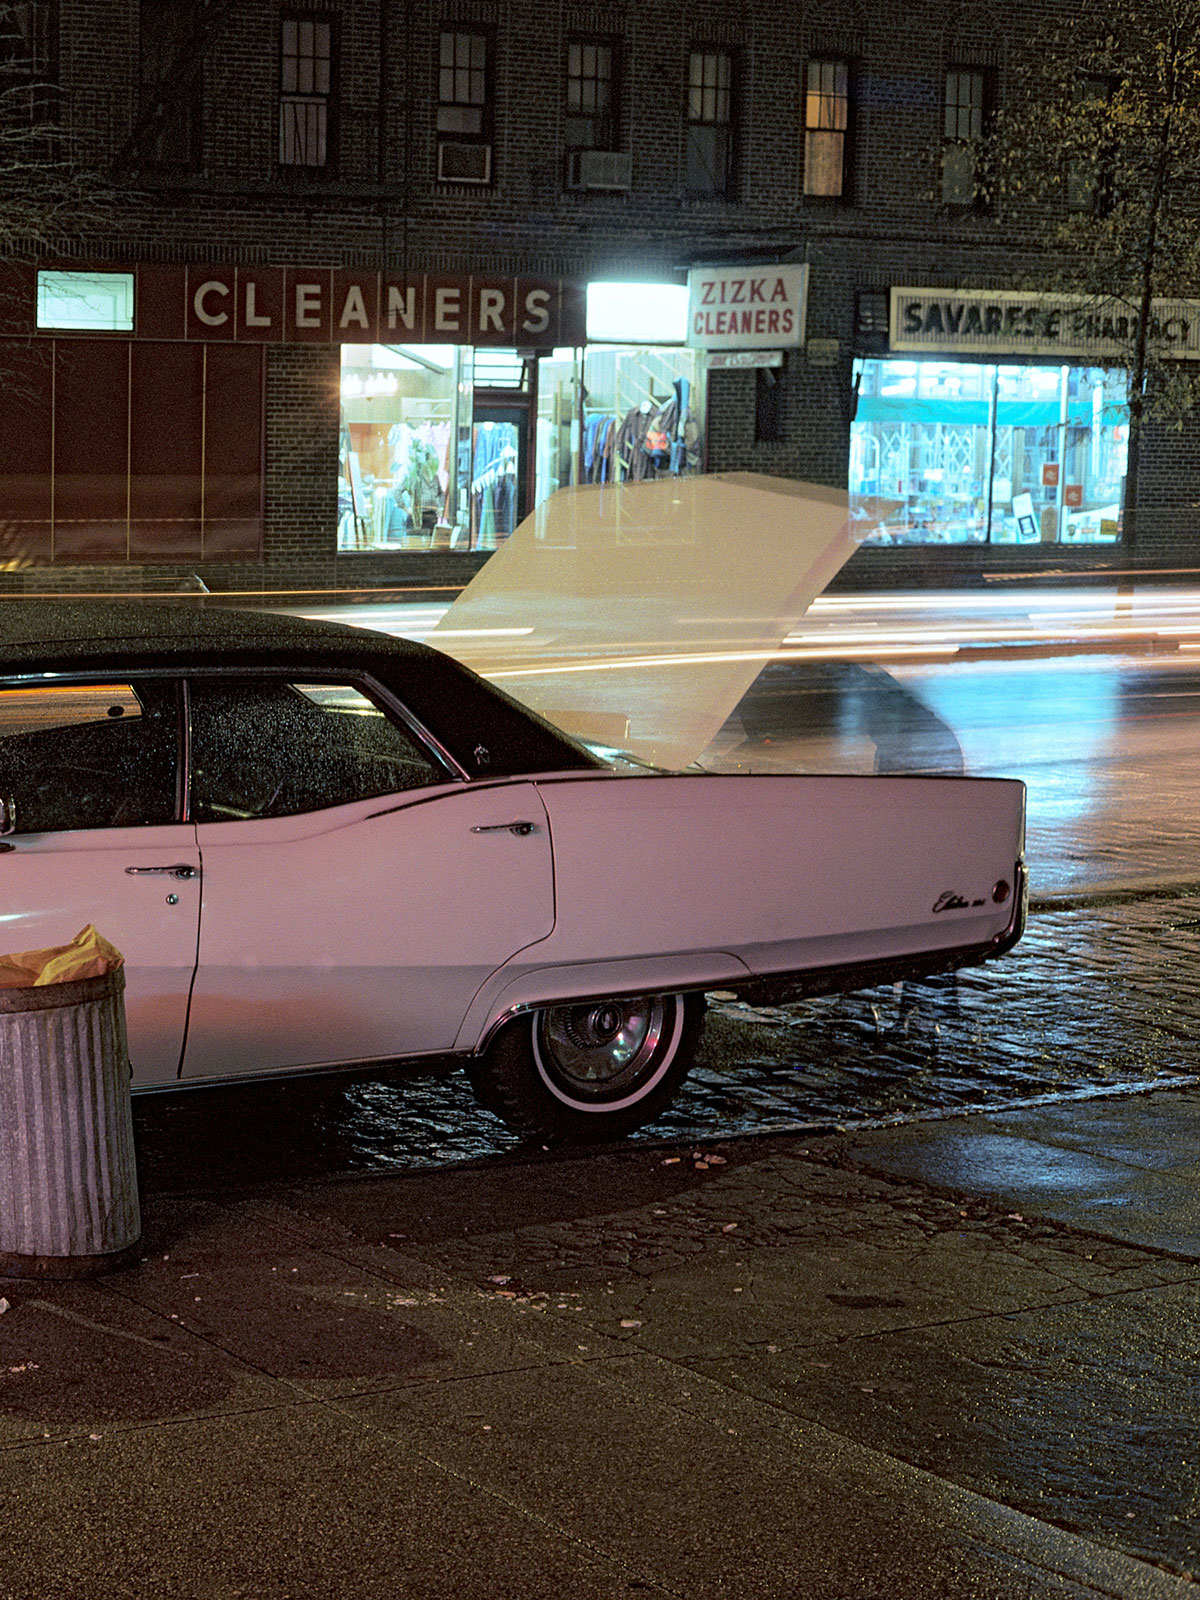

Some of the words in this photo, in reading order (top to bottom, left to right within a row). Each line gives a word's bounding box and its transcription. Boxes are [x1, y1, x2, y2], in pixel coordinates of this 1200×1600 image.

[193, 280, 551, 334] CLEANERS
[701, 278, 788, 305] ZIZKA
[694, 308, 794, 335] CLEANERS
[903, 303, 1061, 338] SAVARESE
